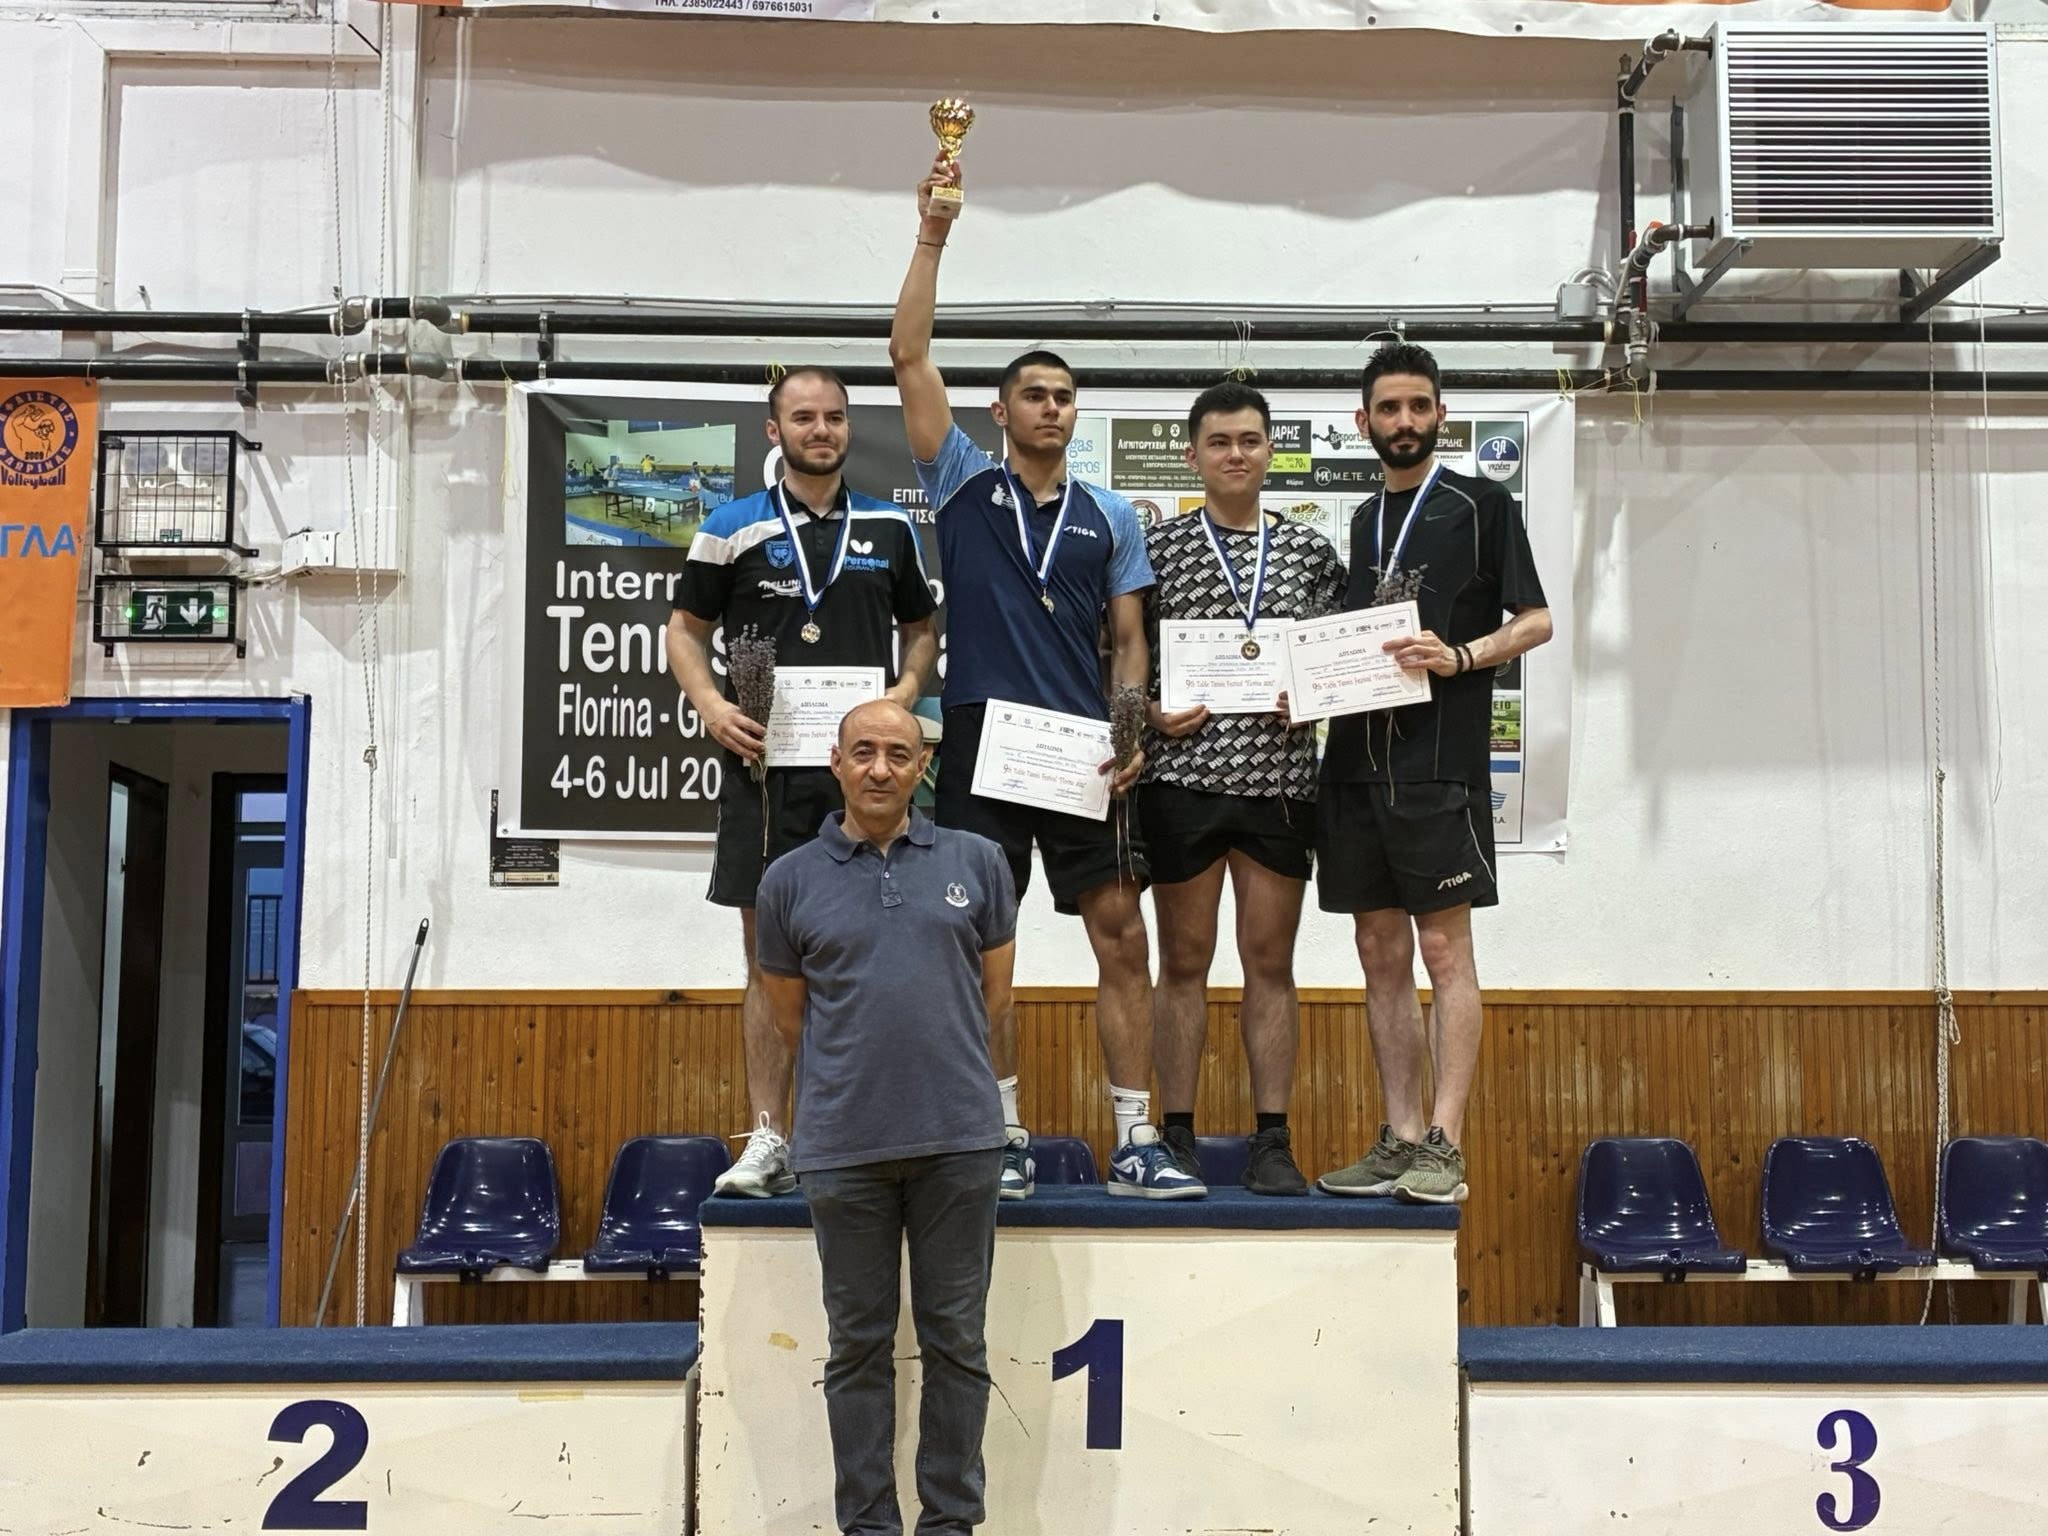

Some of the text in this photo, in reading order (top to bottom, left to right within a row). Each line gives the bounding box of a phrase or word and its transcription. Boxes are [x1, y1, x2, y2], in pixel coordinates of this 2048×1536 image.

[752, 2, 812, 12] 6976615031
[1068, 440, 1093, 458] gas
[1, 464, 66, 489] Volleyball
[1063, 525, 1097, 538] STIGA
[845, 555, 889, 569] Personal
[559, 683, 652, 738] Florina
[1493, 700, 1511, 710] ΕΙΟ
[551, 754, 722, 801] 4-6 Jul 20
[1437, 871, 1473, 890] STIGA
[1052, 1319, 1124, 1450] 1
[261, 1400, 369, 1530] 2
[1815, 1409, 1881, 1533] 3
